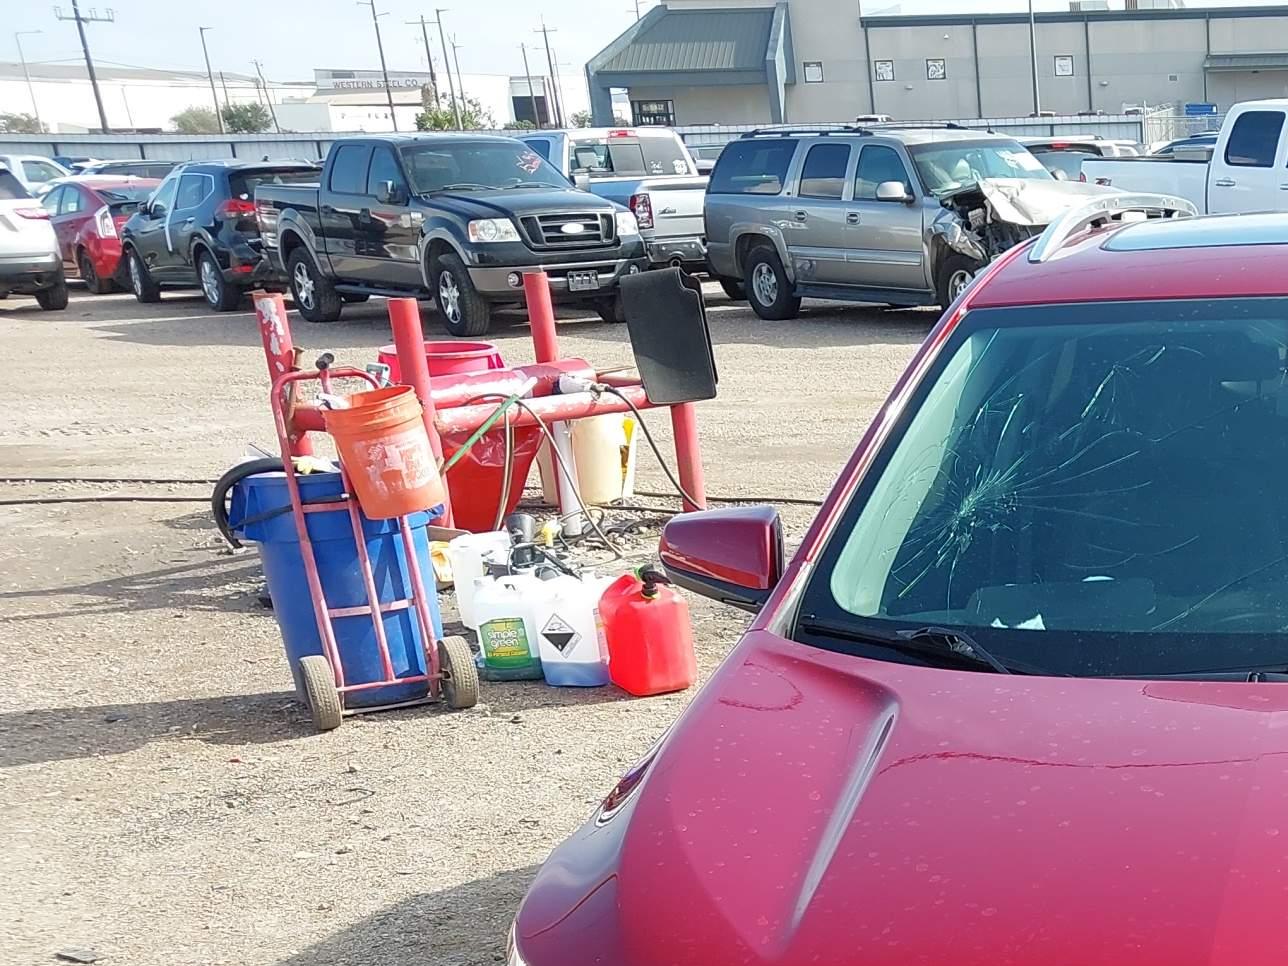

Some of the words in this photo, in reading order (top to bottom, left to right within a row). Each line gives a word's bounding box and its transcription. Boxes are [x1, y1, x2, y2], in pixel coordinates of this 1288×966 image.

[333, 80, 373, 89] WESTERN
[487, 629, 518, 640] simple
[490, 638, 519, 650] green
